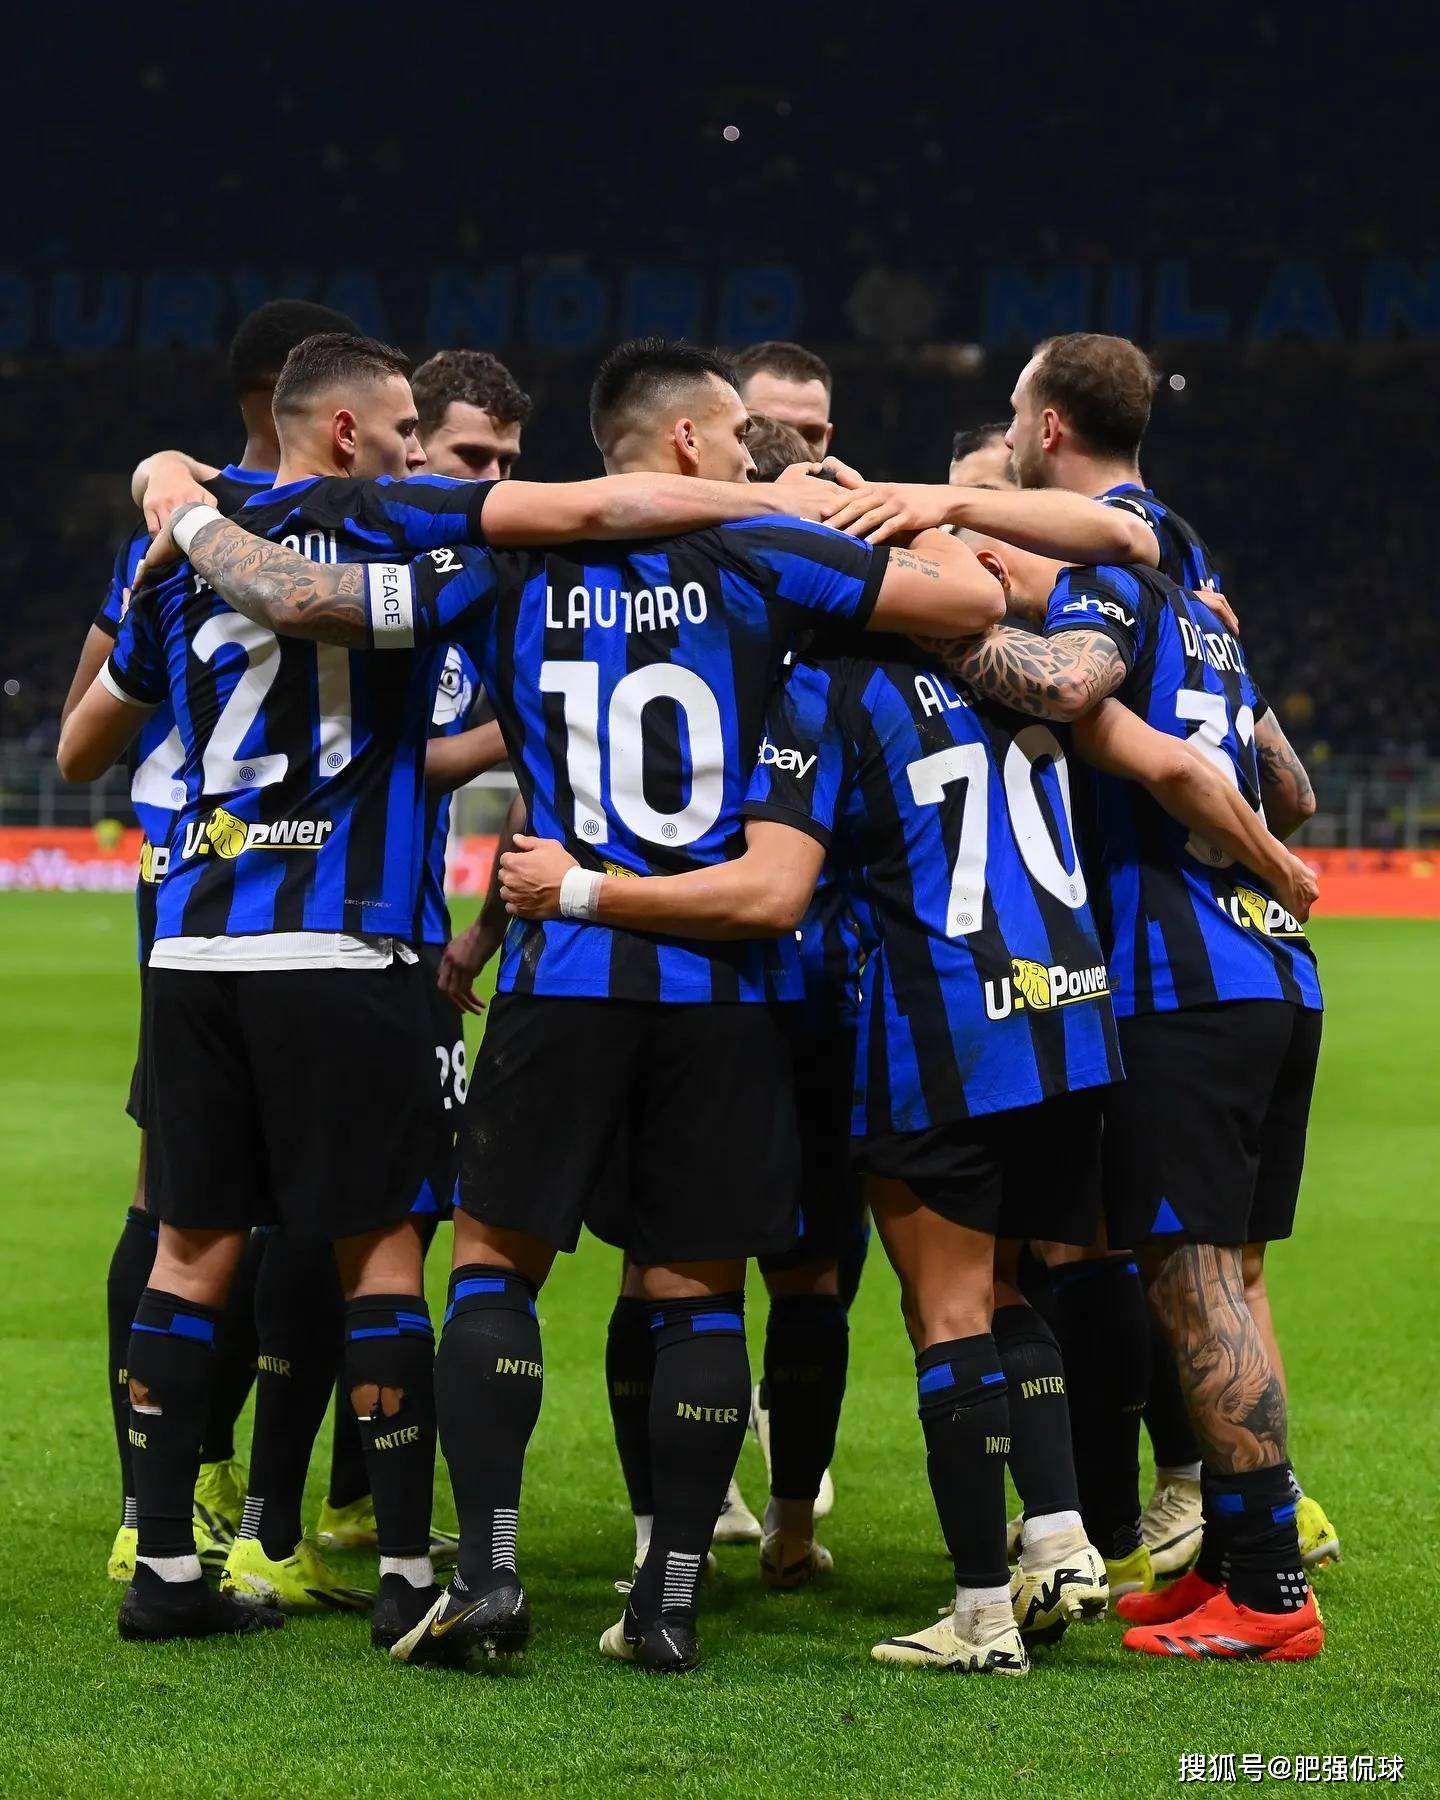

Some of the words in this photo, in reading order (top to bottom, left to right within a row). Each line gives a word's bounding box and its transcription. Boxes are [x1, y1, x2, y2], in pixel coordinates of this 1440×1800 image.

[381, 566, 401, 626] PEACE
[545, 581, 708, 634] LAUTARO
[191, 612, 353, 796] 21
[539, 660, 725, 848] 10
[757, 736, 818, 779] bay
[906, 724, 1088, 937] 70
[1048, 965, 1108, 1008] Power
[495, 1357, 543, 1379] INTER
[1021, 1376, 1065, 1399] INTER
[676, 1401, 739, 1424] INTER
[374, 1425, 420, 1451] INTER
